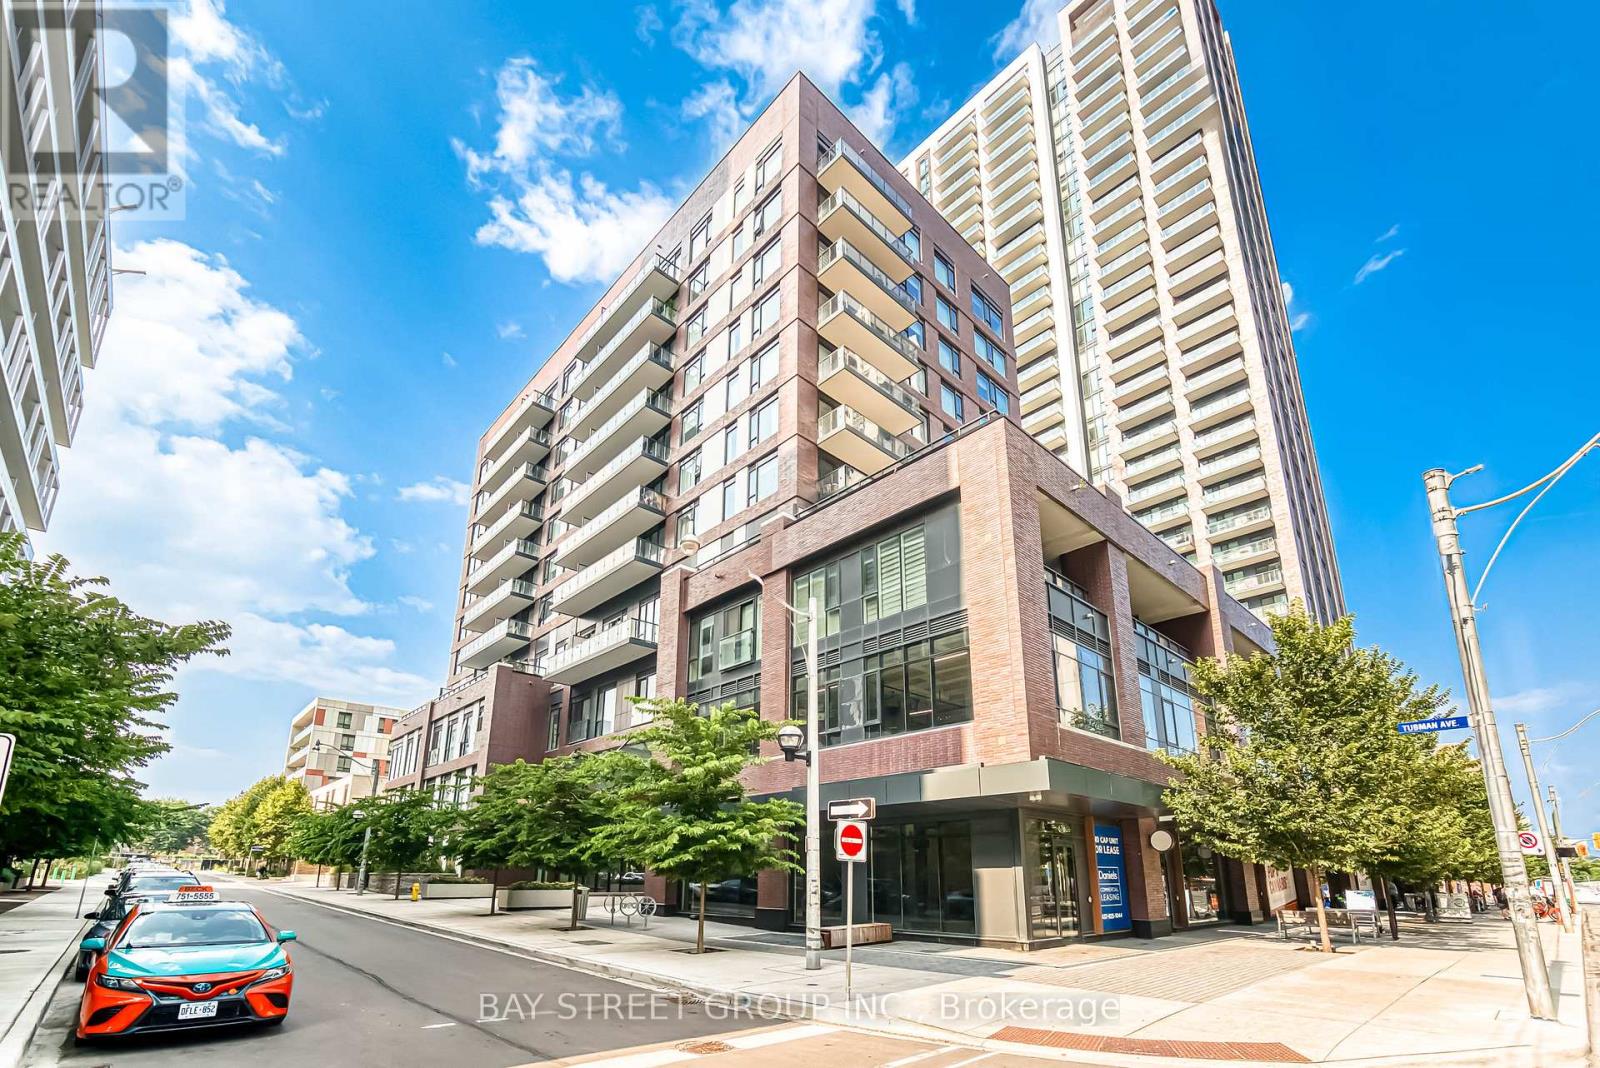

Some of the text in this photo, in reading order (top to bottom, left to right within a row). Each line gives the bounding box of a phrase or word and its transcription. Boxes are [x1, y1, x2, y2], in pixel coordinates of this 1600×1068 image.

[1402, 719, 1460, 732] TUBMAN AVE.
[1095, 845, 1120, 855] OR LEASE
[1098, 870, 1118, 880] Daniels
[176, 892, 215, 900] 751-5555
[1100, 893, 1120, 901] LEASING
